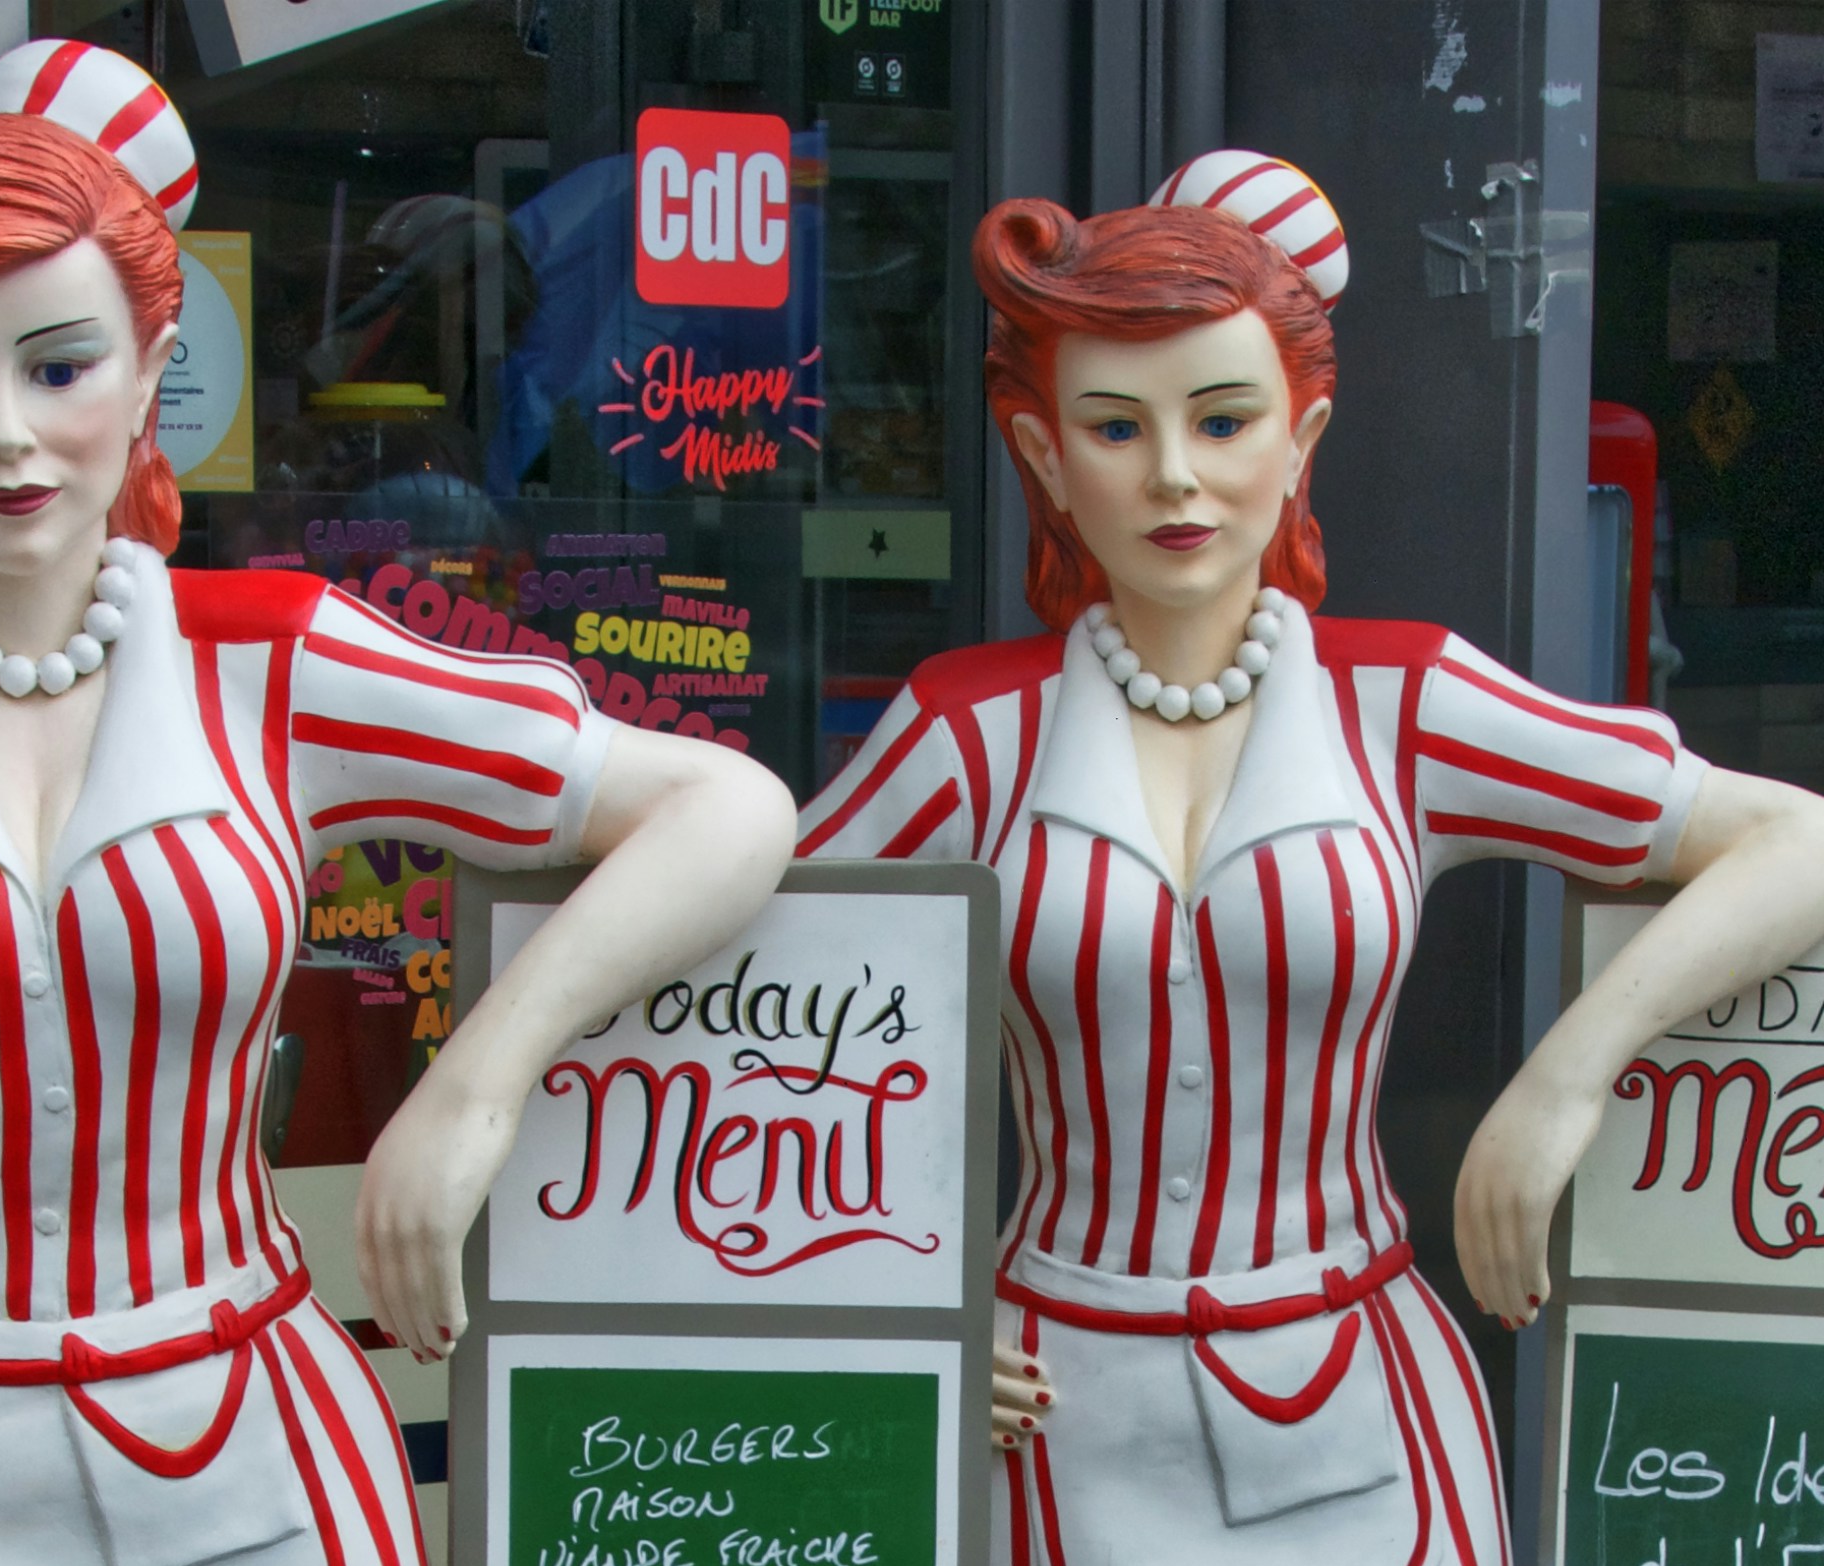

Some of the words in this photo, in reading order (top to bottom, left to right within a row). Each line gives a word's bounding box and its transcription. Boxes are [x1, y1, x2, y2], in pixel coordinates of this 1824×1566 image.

[870, 10, 901, 28] BAR
[640, 145, 788, 266] CdC
[642, 343, 794, 423] Happy
[661, 422, 782, 492] Midis
[518, 563, 661, 616] SOCIAL
[339, 937, 402, 970] FRAIS
[579, 948, 923, 1096] oday's
[537, 1056, 941, 1278] Menu
[569, 1415, 837, 1478] BURGERS
[1593, 1380, 1727, 1499] Les
